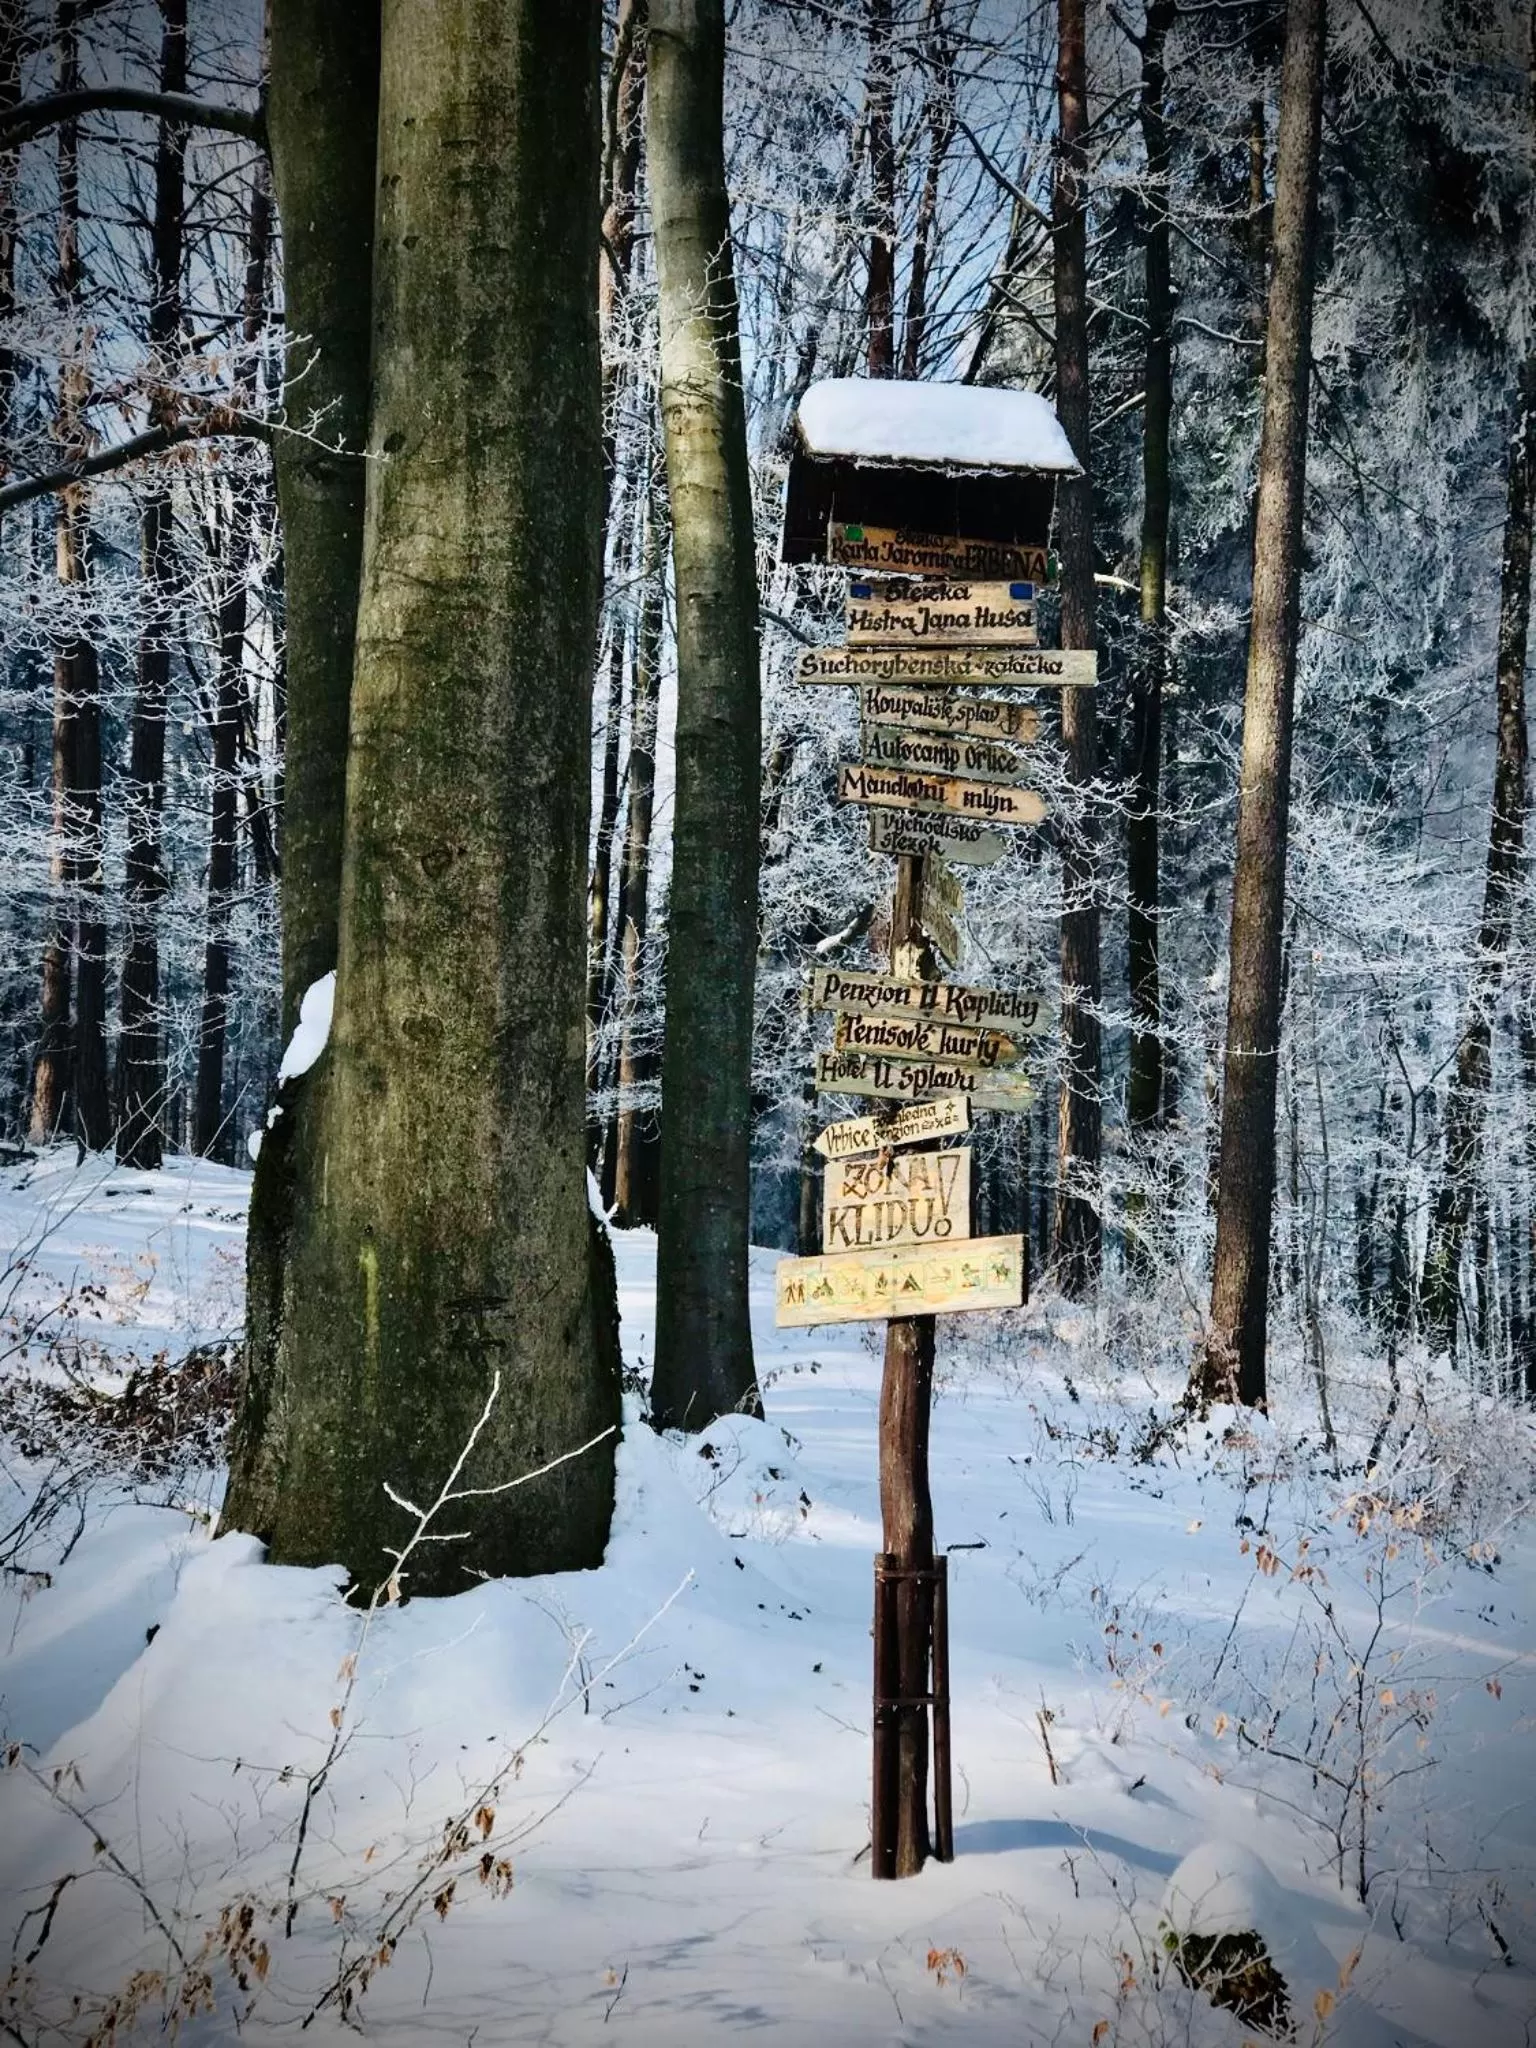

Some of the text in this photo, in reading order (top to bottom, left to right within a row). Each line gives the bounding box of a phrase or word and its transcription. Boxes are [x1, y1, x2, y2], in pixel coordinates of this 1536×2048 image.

[832, 537, 879, 562] Karla
[885, 582, 972, 601] Stezka
[849, 606, 1034, 636] Mistra Jana Husa
[823, 973, 1040, 1027] Penzion U Kapličky
[842, 1012, 935, 1052] Tenisové
